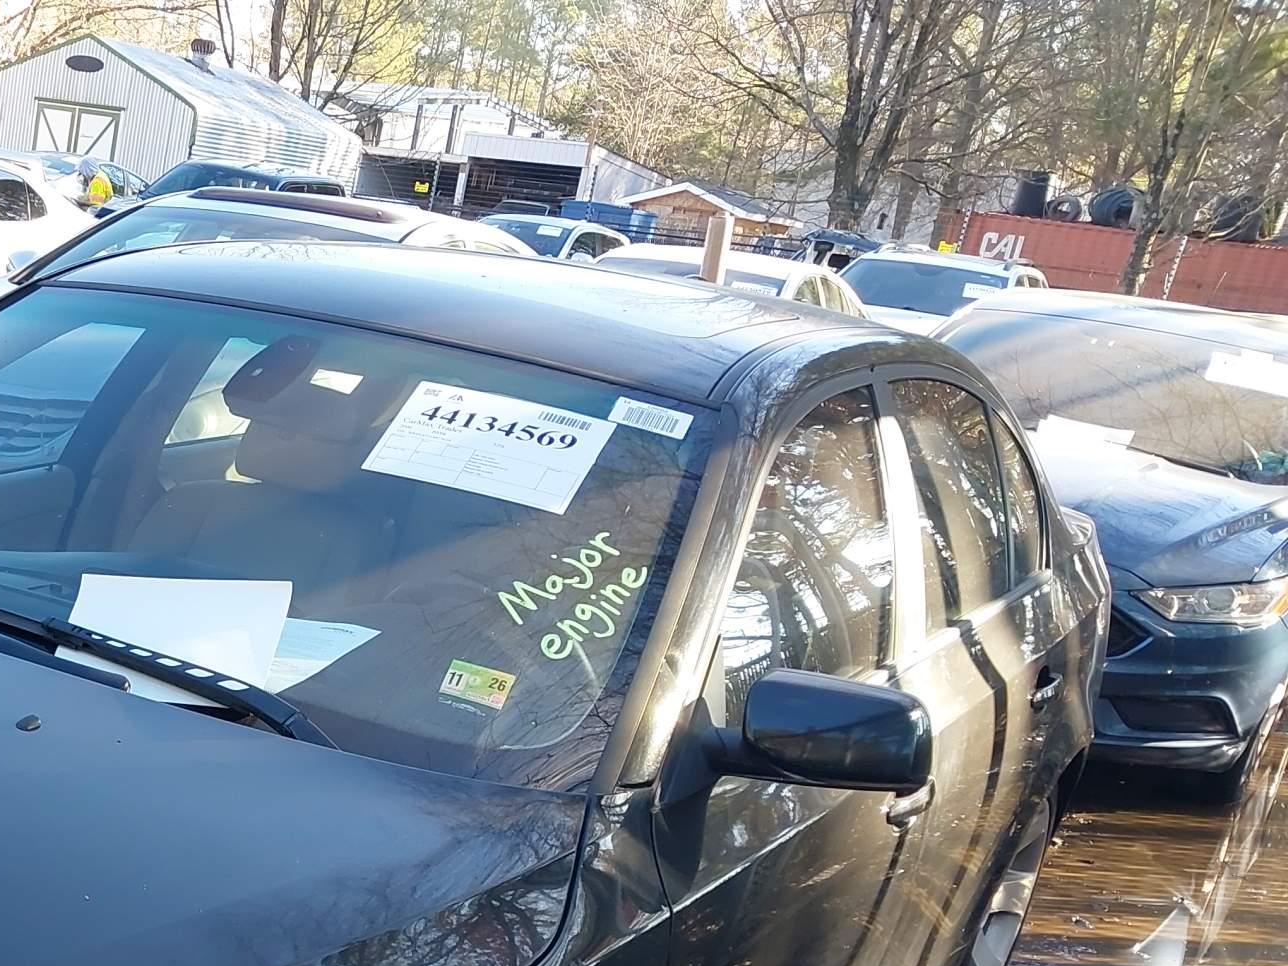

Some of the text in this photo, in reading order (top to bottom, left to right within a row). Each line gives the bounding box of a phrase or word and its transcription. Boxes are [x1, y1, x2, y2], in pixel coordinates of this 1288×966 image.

[420, 405, 579, 449] 44134569
[497, 532, 620, 625] Major
[540, 567, 647, 660] engine
[447, 671, 508, 692] 11 26
